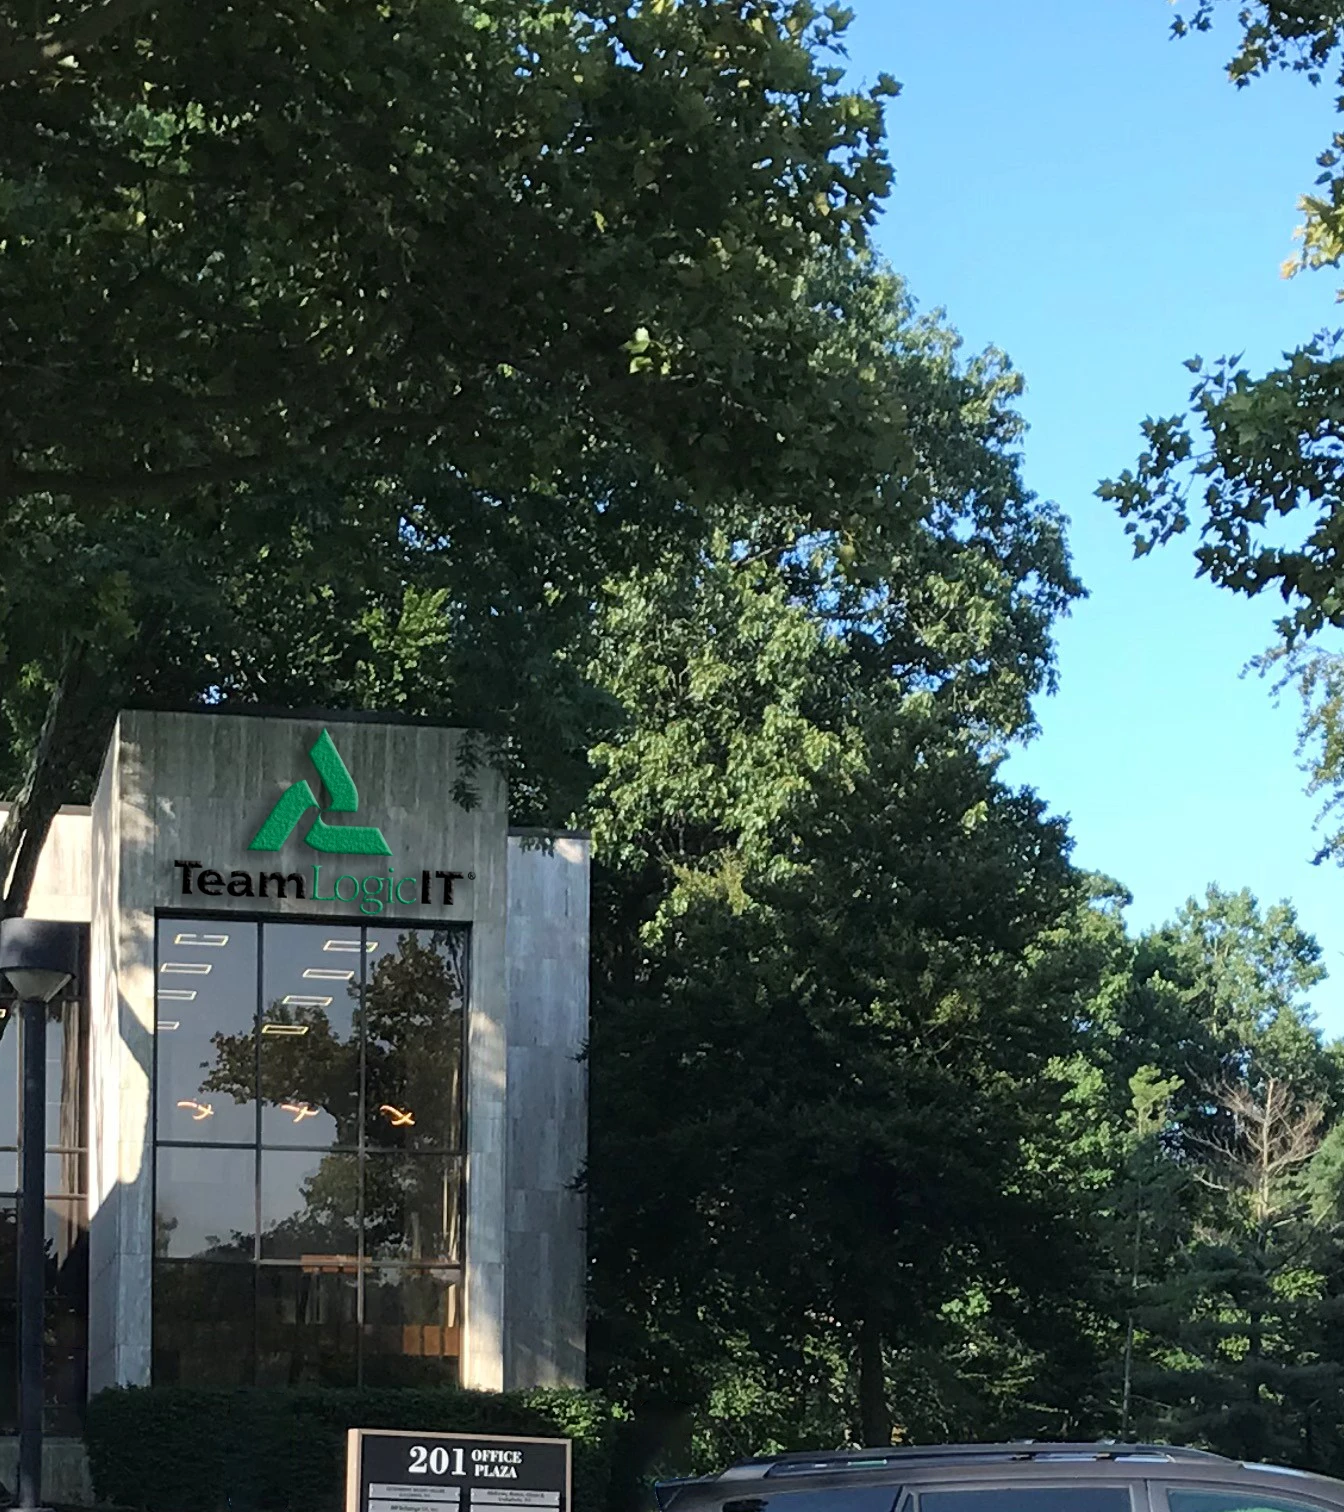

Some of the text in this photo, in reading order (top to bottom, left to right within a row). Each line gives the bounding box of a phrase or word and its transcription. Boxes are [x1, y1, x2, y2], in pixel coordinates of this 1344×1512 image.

[408, 1445, 467, 1476] 201
[471, 1449, 523, 1464] OFFICE
[474, 1464, 517, 1479] PLAZA
